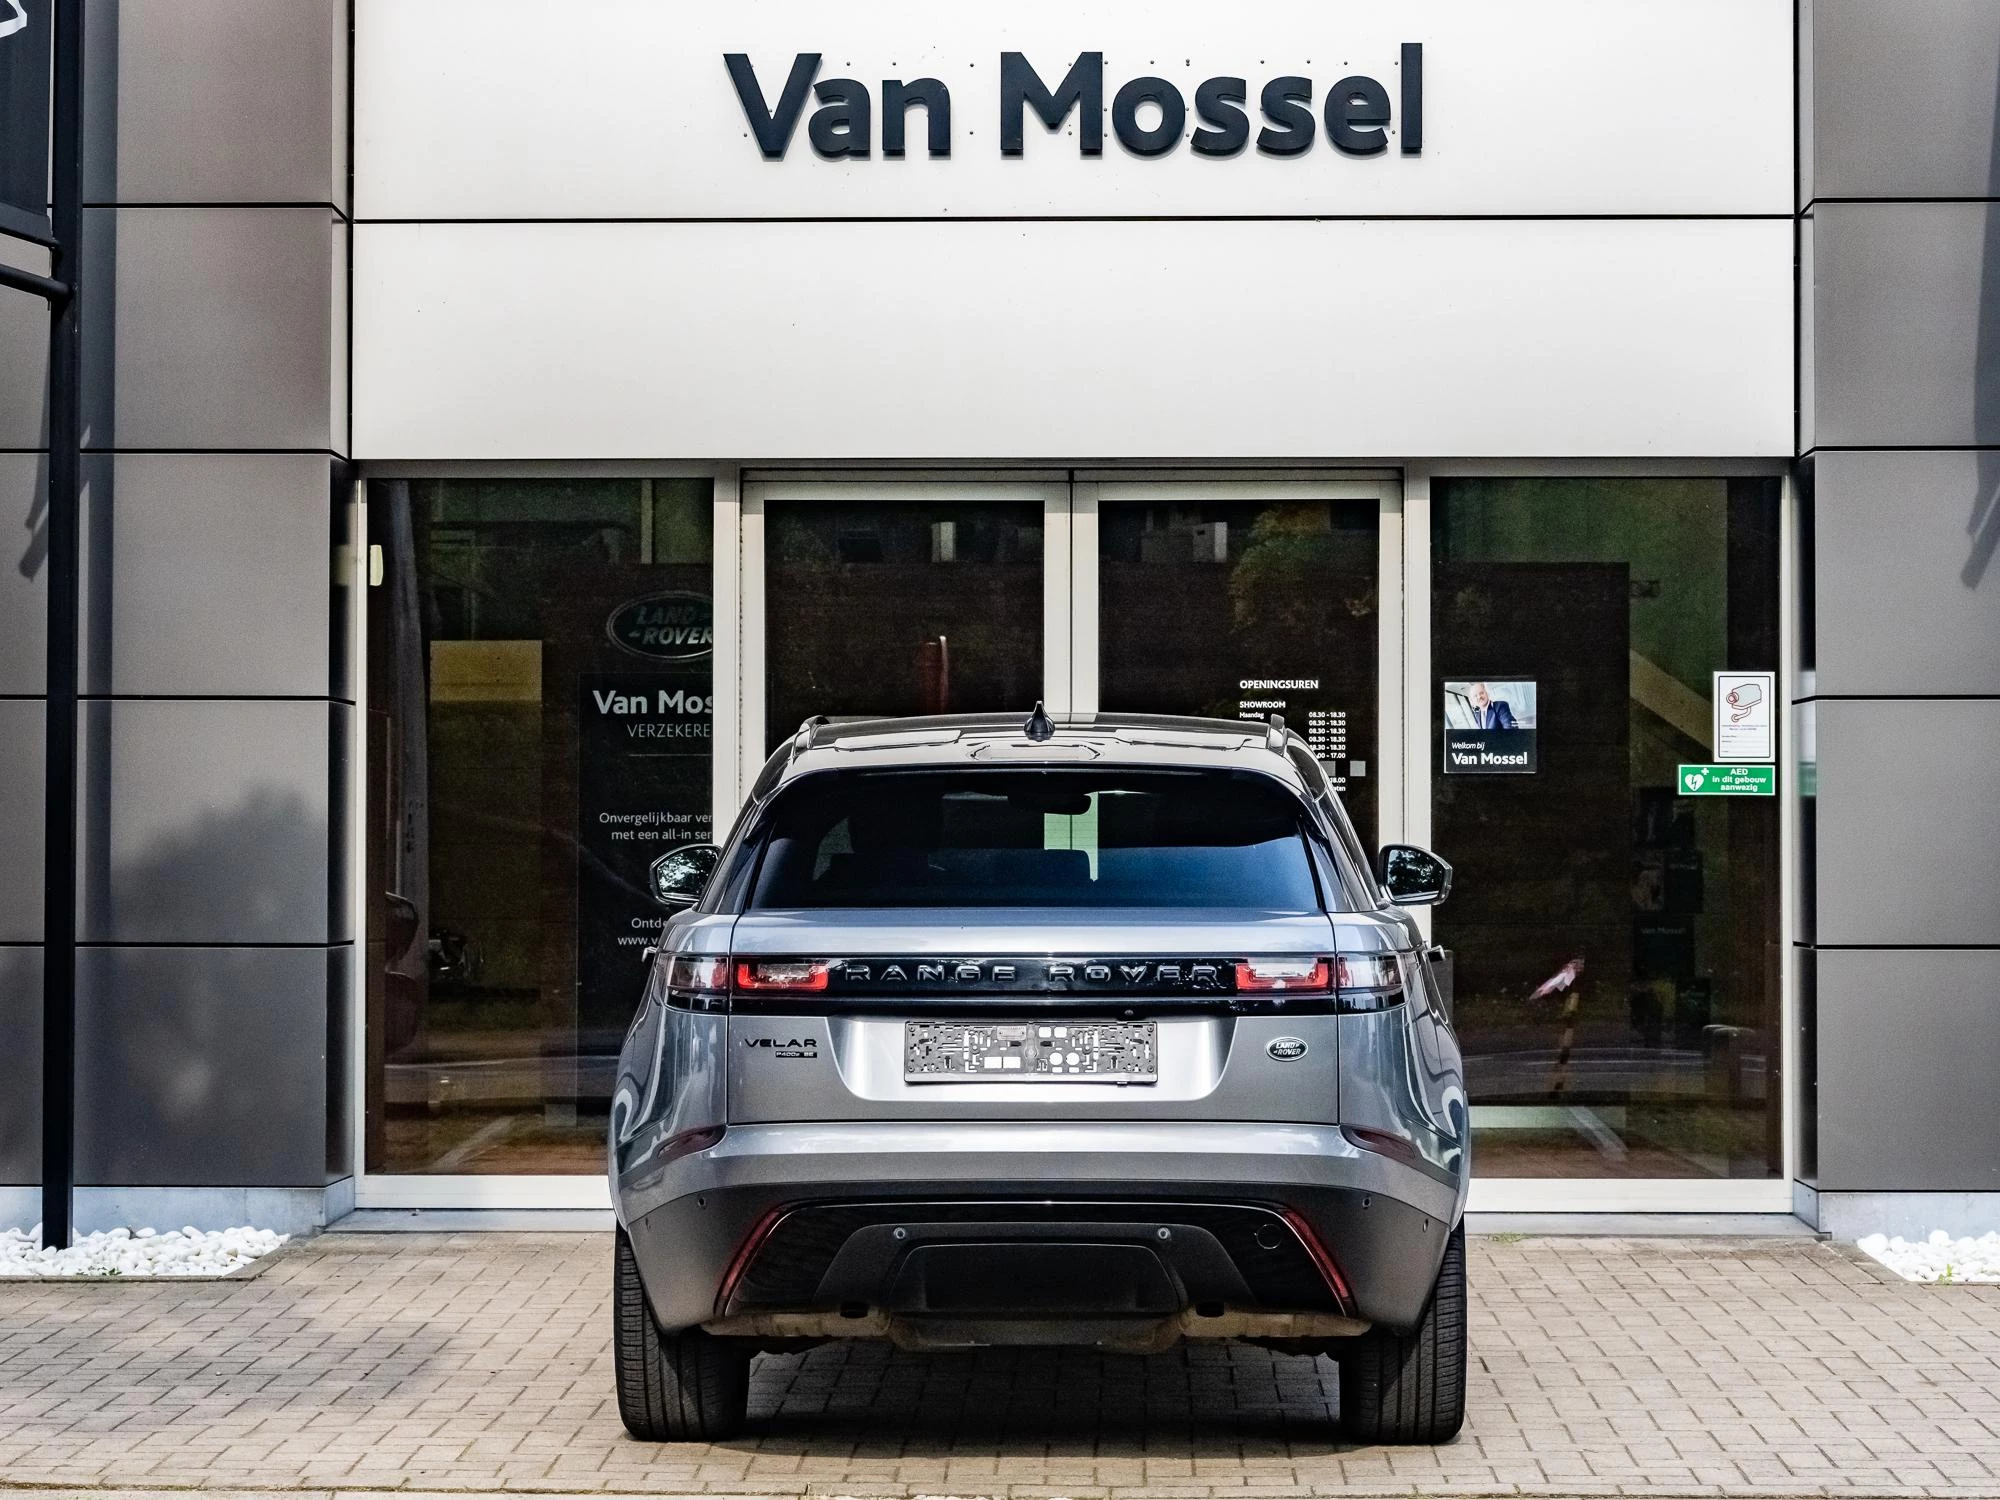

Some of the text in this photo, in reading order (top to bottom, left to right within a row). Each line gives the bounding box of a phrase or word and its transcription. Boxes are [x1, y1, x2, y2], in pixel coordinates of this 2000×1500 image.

[723, 42, 1423, 159] Van Mossel
[636, 606, 697, 625] LAND
[1239, 680, 1319, 689] OPENINGSUREN
[592, 690, 648, 714] Van
[1477, 742, 1486, 750] bij
[1452, 751, 1528, 765] Van Mossel
[1734, 776, 1767, 784] gebouw
[1720, 784, 1758, 792] aanwezig
[599, 812, 692, 826] Onvergelijkbaar
[611, 831, 635, 840] met
[638, 831, 659, 840] een
[662, 829, 692, 840] all-in
[845, 964, 1219, 984] RANGE ROVER
[744, 1038, 817, 1048] VELAR
